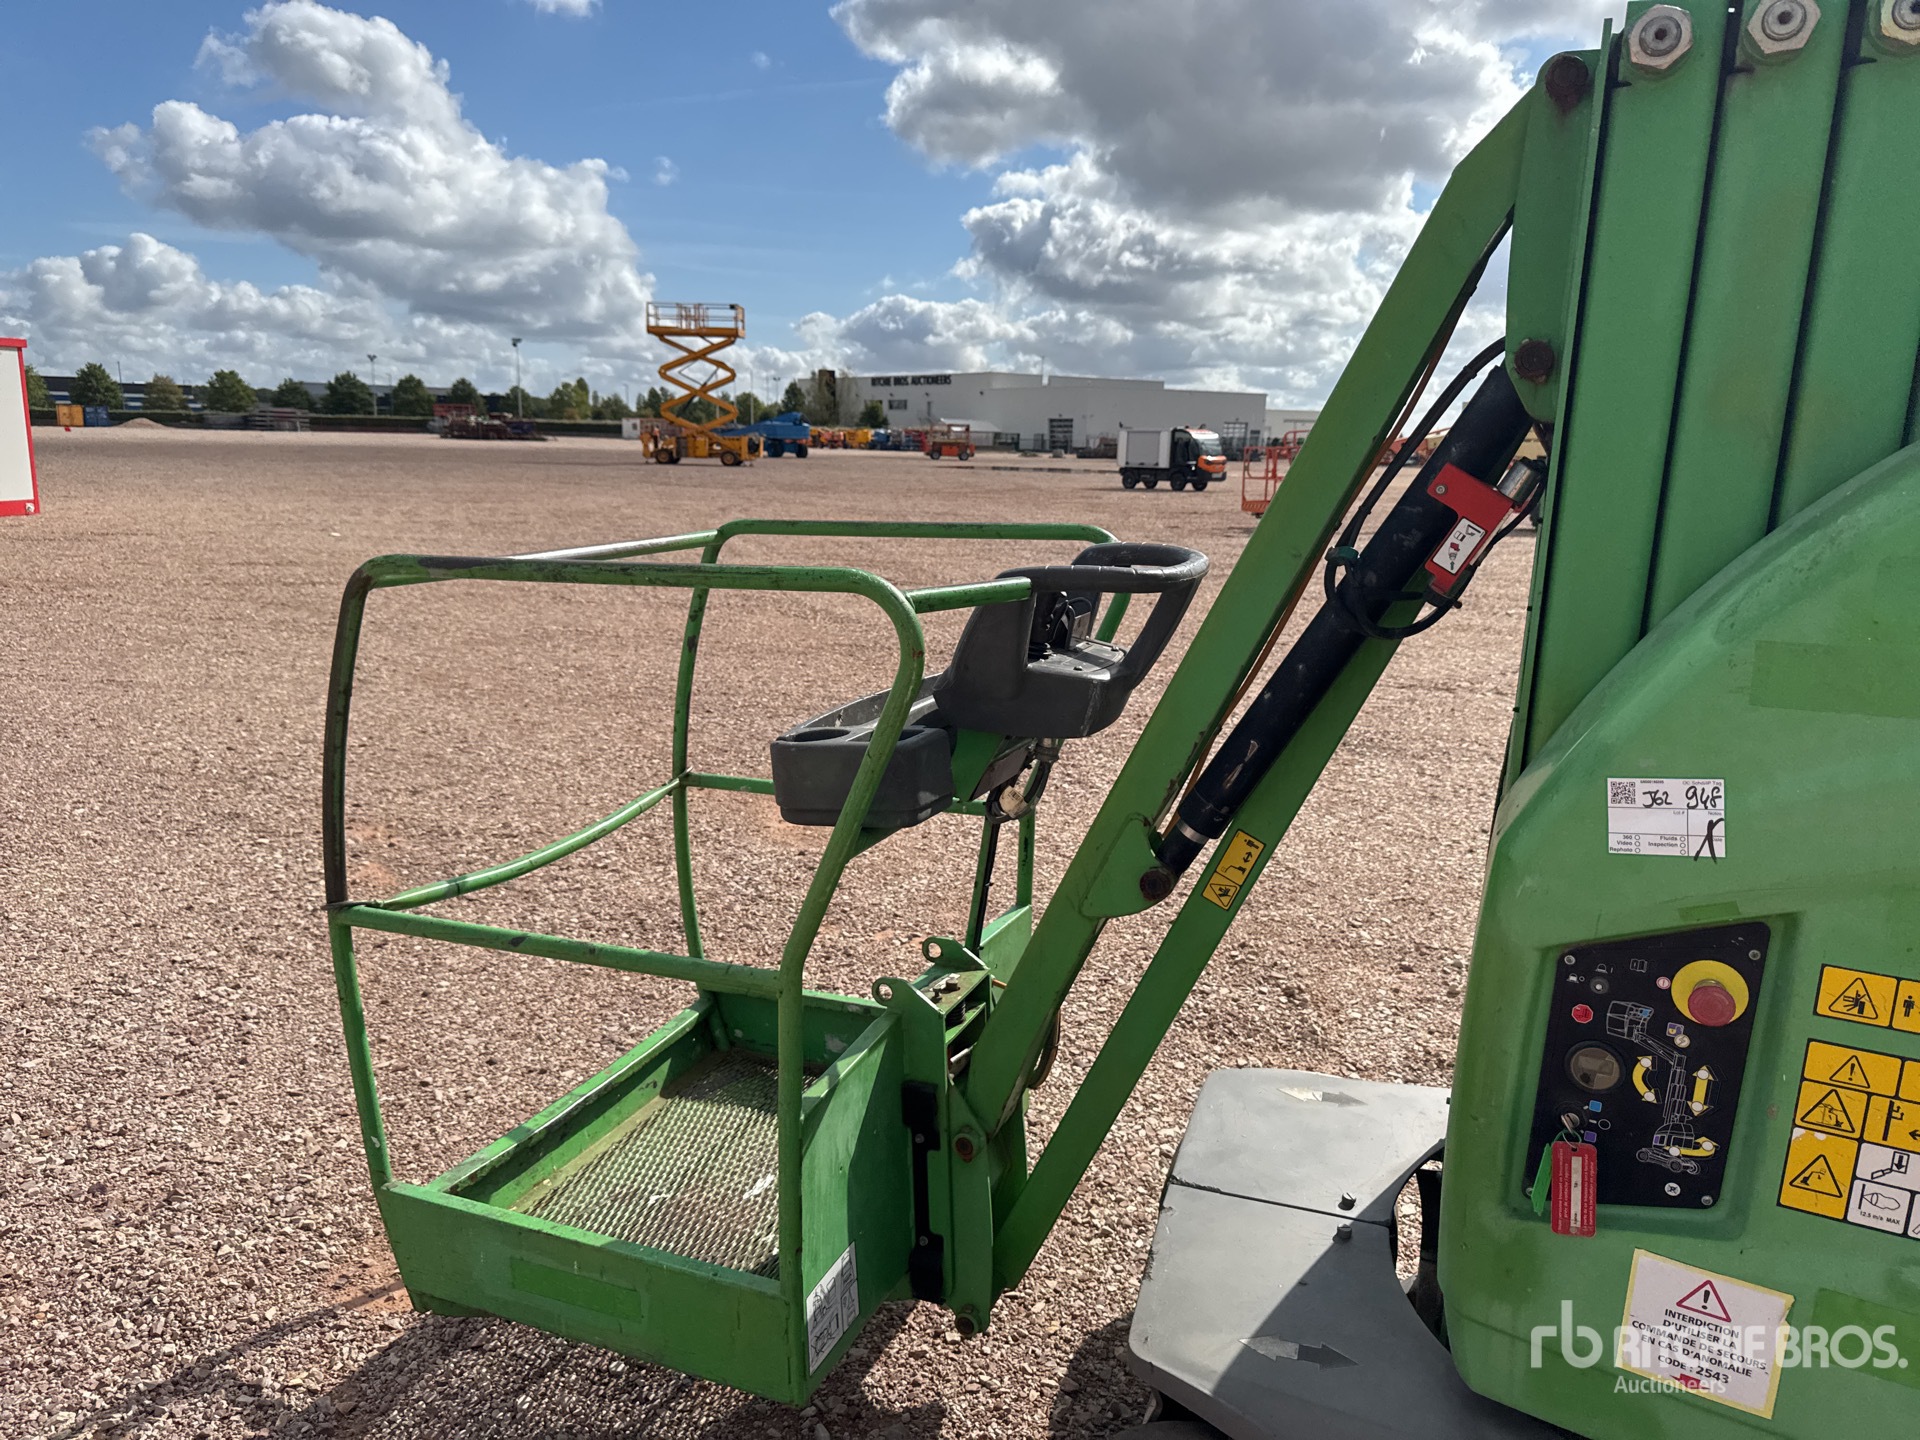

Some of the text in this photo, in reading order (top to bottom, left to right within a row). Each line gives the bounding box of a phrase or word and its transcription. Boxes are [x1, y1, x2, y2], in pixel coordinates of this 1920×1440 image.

[1860, 1210, 1871, 1218] 12.5
[1886, 1217, 1900, 1225] MAX
[1664, 1308, 1740, 1339] INTERDICTION
[1632, 1320, 1767, 1370] COMMANDE DE SECOURS
[1641, 1334, 1656, 1345] EN
[1658, 1339, 1679, 1353] CAS
[1723, 1338, 1737, 1349] LA
[1658, 1355, 1687, 1371] CODE
[1695, 1365, 1730, 1384] 2543
